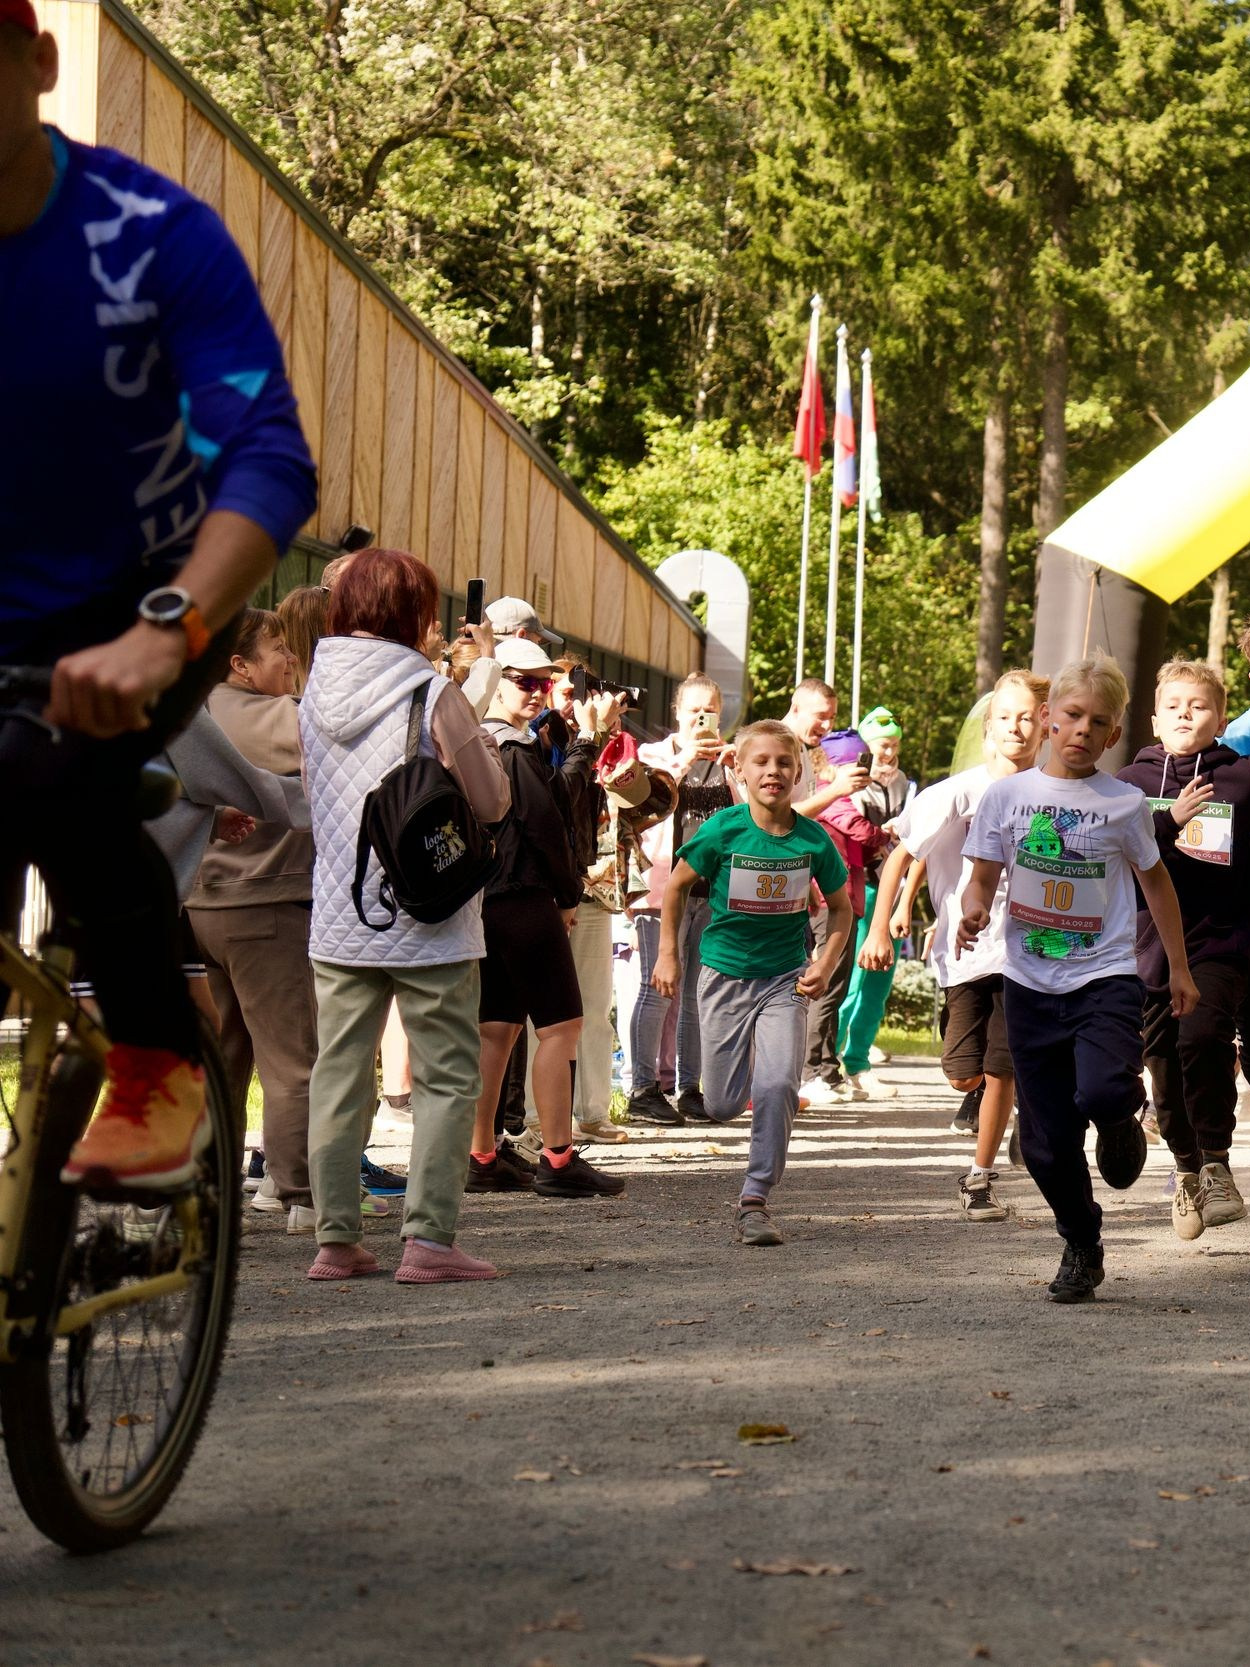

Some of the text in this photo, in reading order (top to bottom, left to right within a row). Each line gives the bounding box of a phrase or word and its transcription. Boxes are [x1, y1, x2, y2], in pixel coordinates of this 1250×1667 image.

[424, 831, 446, 850] love
[436, 843, 446, 856] to
[741, 859, 804, 870] КРОСС ДУБКИ
[1024, 856, 1098, 876] КРОСС ДУБКИ
[756, 874, 788, 899] 32
[1041, 879, 1074, 912] 10
